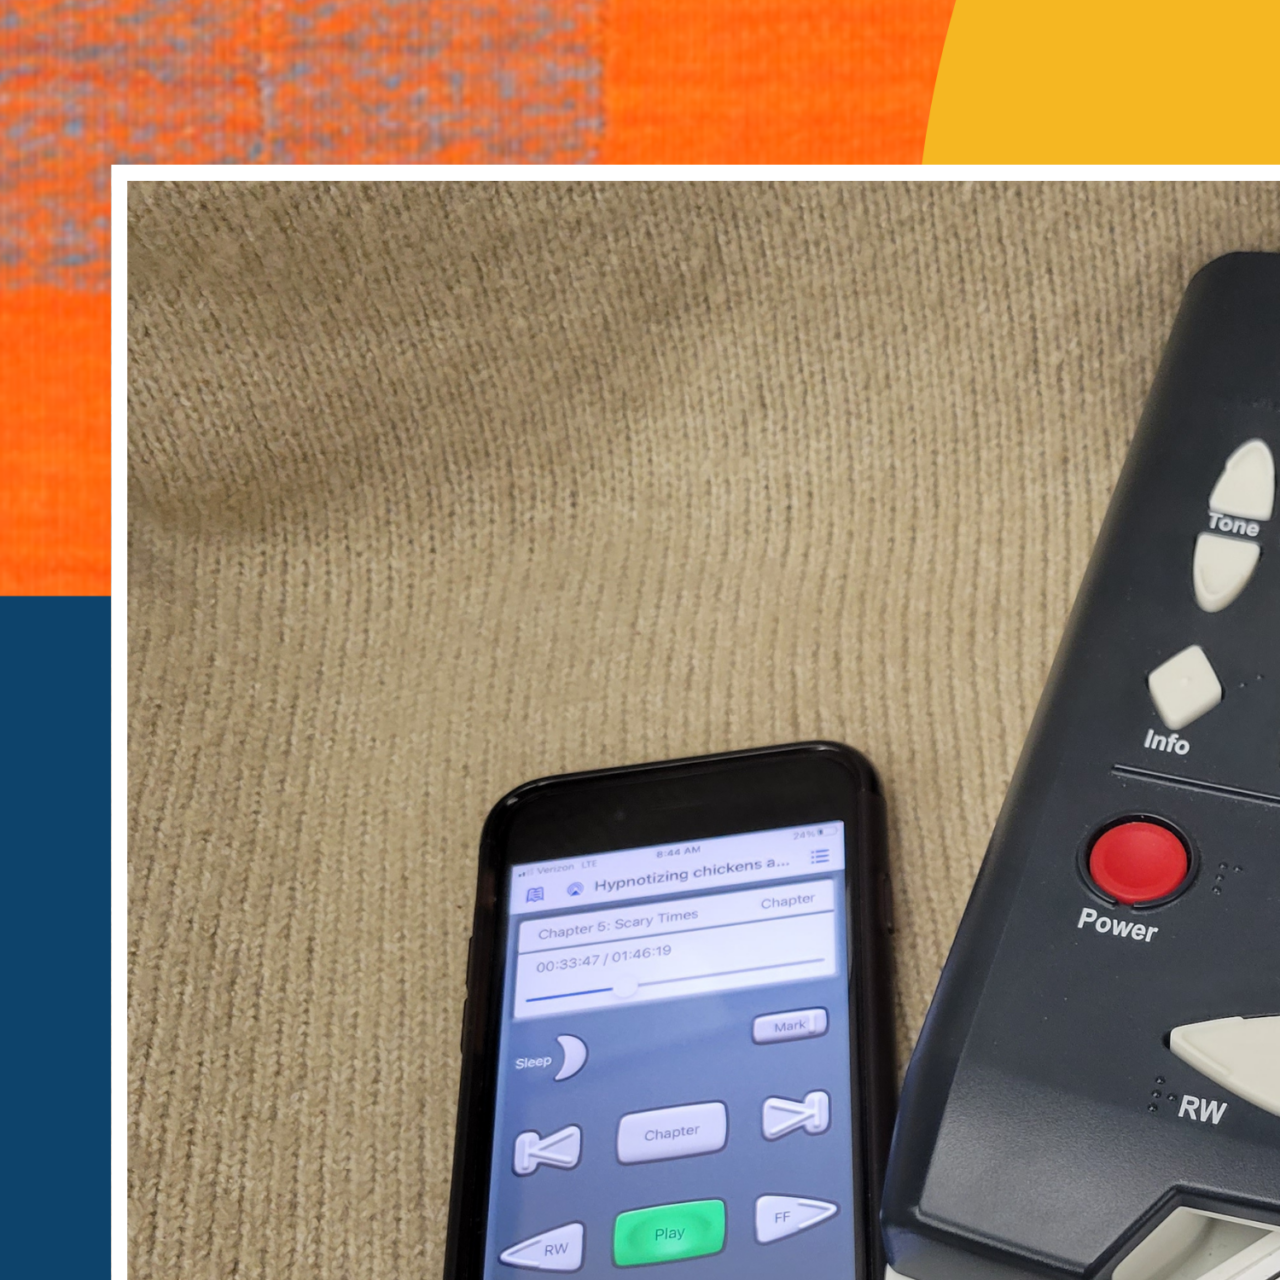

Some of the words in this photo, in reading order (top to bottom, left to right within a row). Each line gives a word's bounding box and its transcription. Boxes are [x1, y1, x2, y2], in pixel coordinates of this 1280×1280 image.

[1209, 512, 1260, 536] Tone
[1144, 729, 1190, 755] Info
[684, 846, 701, 855] AM
[537, 863, 574, 875] Verizon
[582, 860, 597, 868] LTE
[595, 869, 688, 892] Hypnotizing
[693, 859, 762, 878] chickens
[762, 893, 815, 910] Chapter
[538, 922, 593, 940] Chapter
[598, 921, 611, 933] 5:
[615, 916, 653, 934] Scary
[657, 909, 698, 924] Times
[1078, 908, 1158, 942] Power
[536, 955, 600, 974] 00:33:47
[612, 945, 671, 962] 01:46:19
[775, 1020, 806, 1033] Mark
[515, 1056, 552, 1071] Sleep
[1178, 1095, 1227, 1125] RW
[644, 1124, 700, 1141] Chapter
[775, 1211, 791, 1223] FF
[655, 1226, 685, 1242] Play
[544, 1243, 568, 1257] RW
